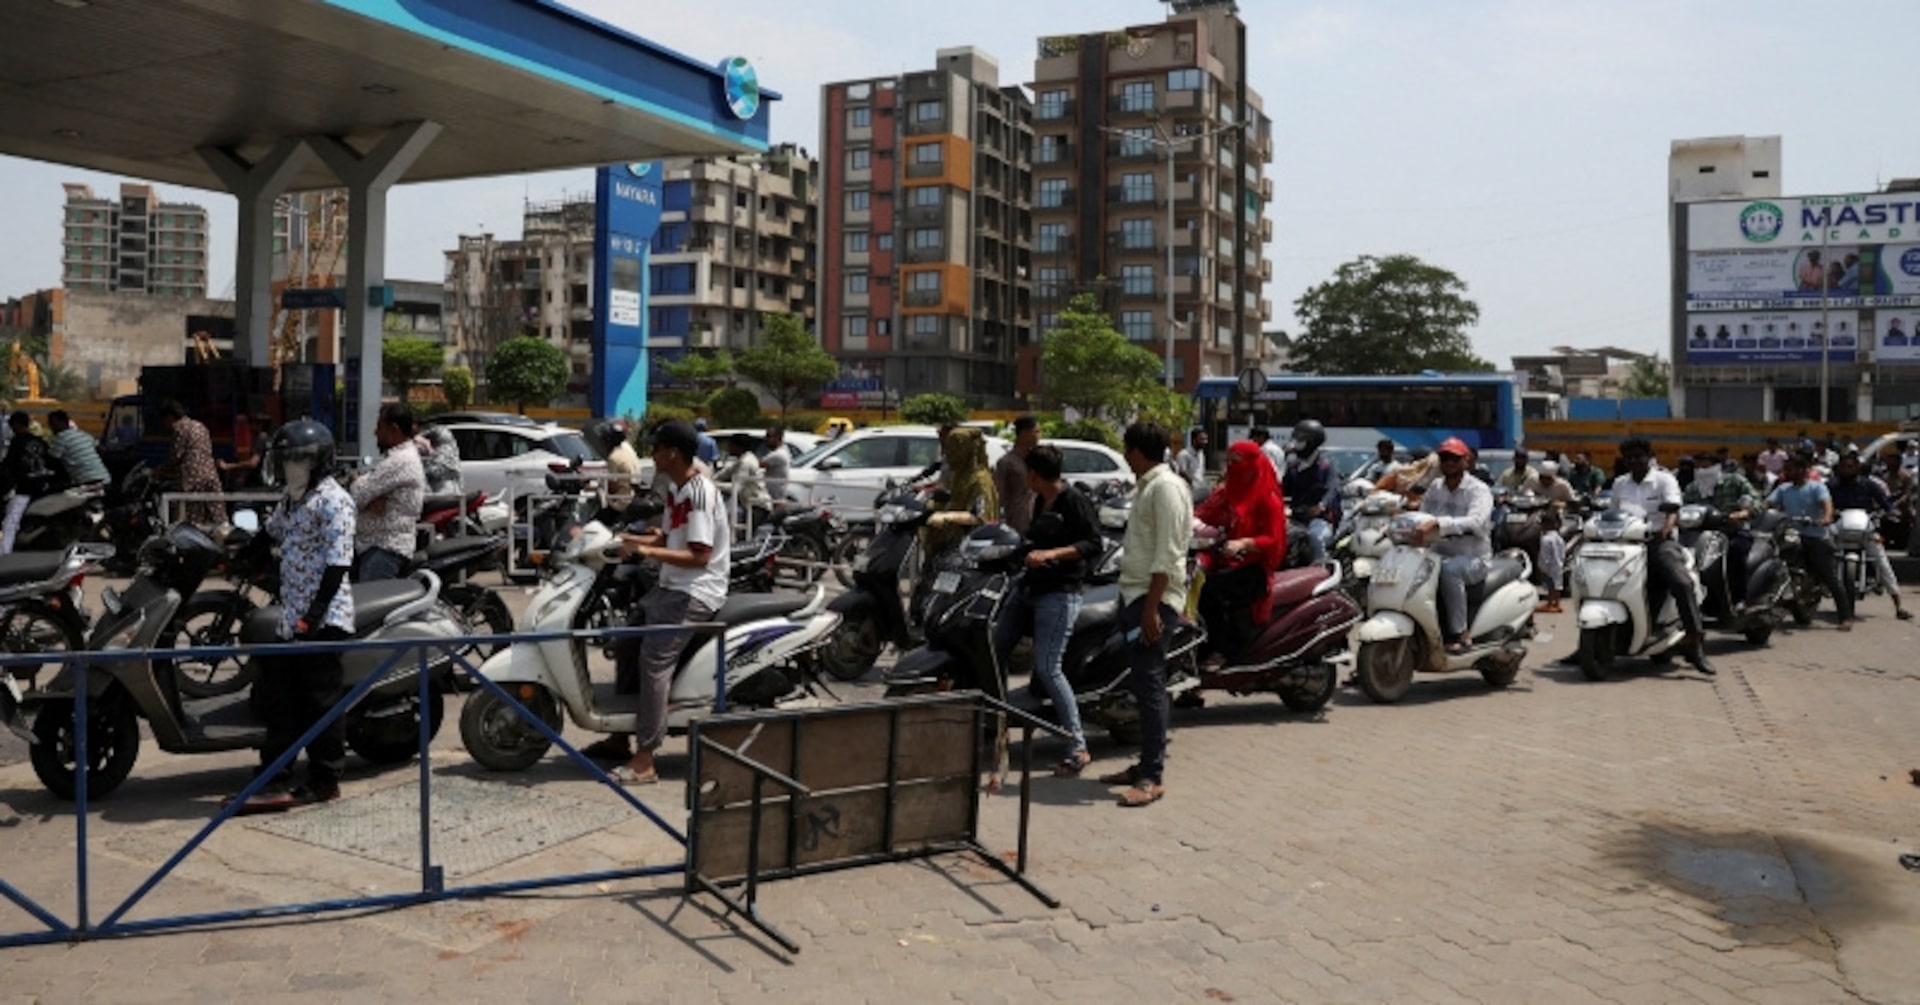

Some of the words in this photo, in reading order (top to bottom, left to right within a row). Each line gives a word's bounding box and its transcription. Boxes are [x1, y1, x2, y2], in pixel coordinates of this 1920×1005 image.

[616, 182, 656, 206] NAYARA
[1802, 202, 1920, 228] MAST
[1802, 228, 1920, 241] ACAD
